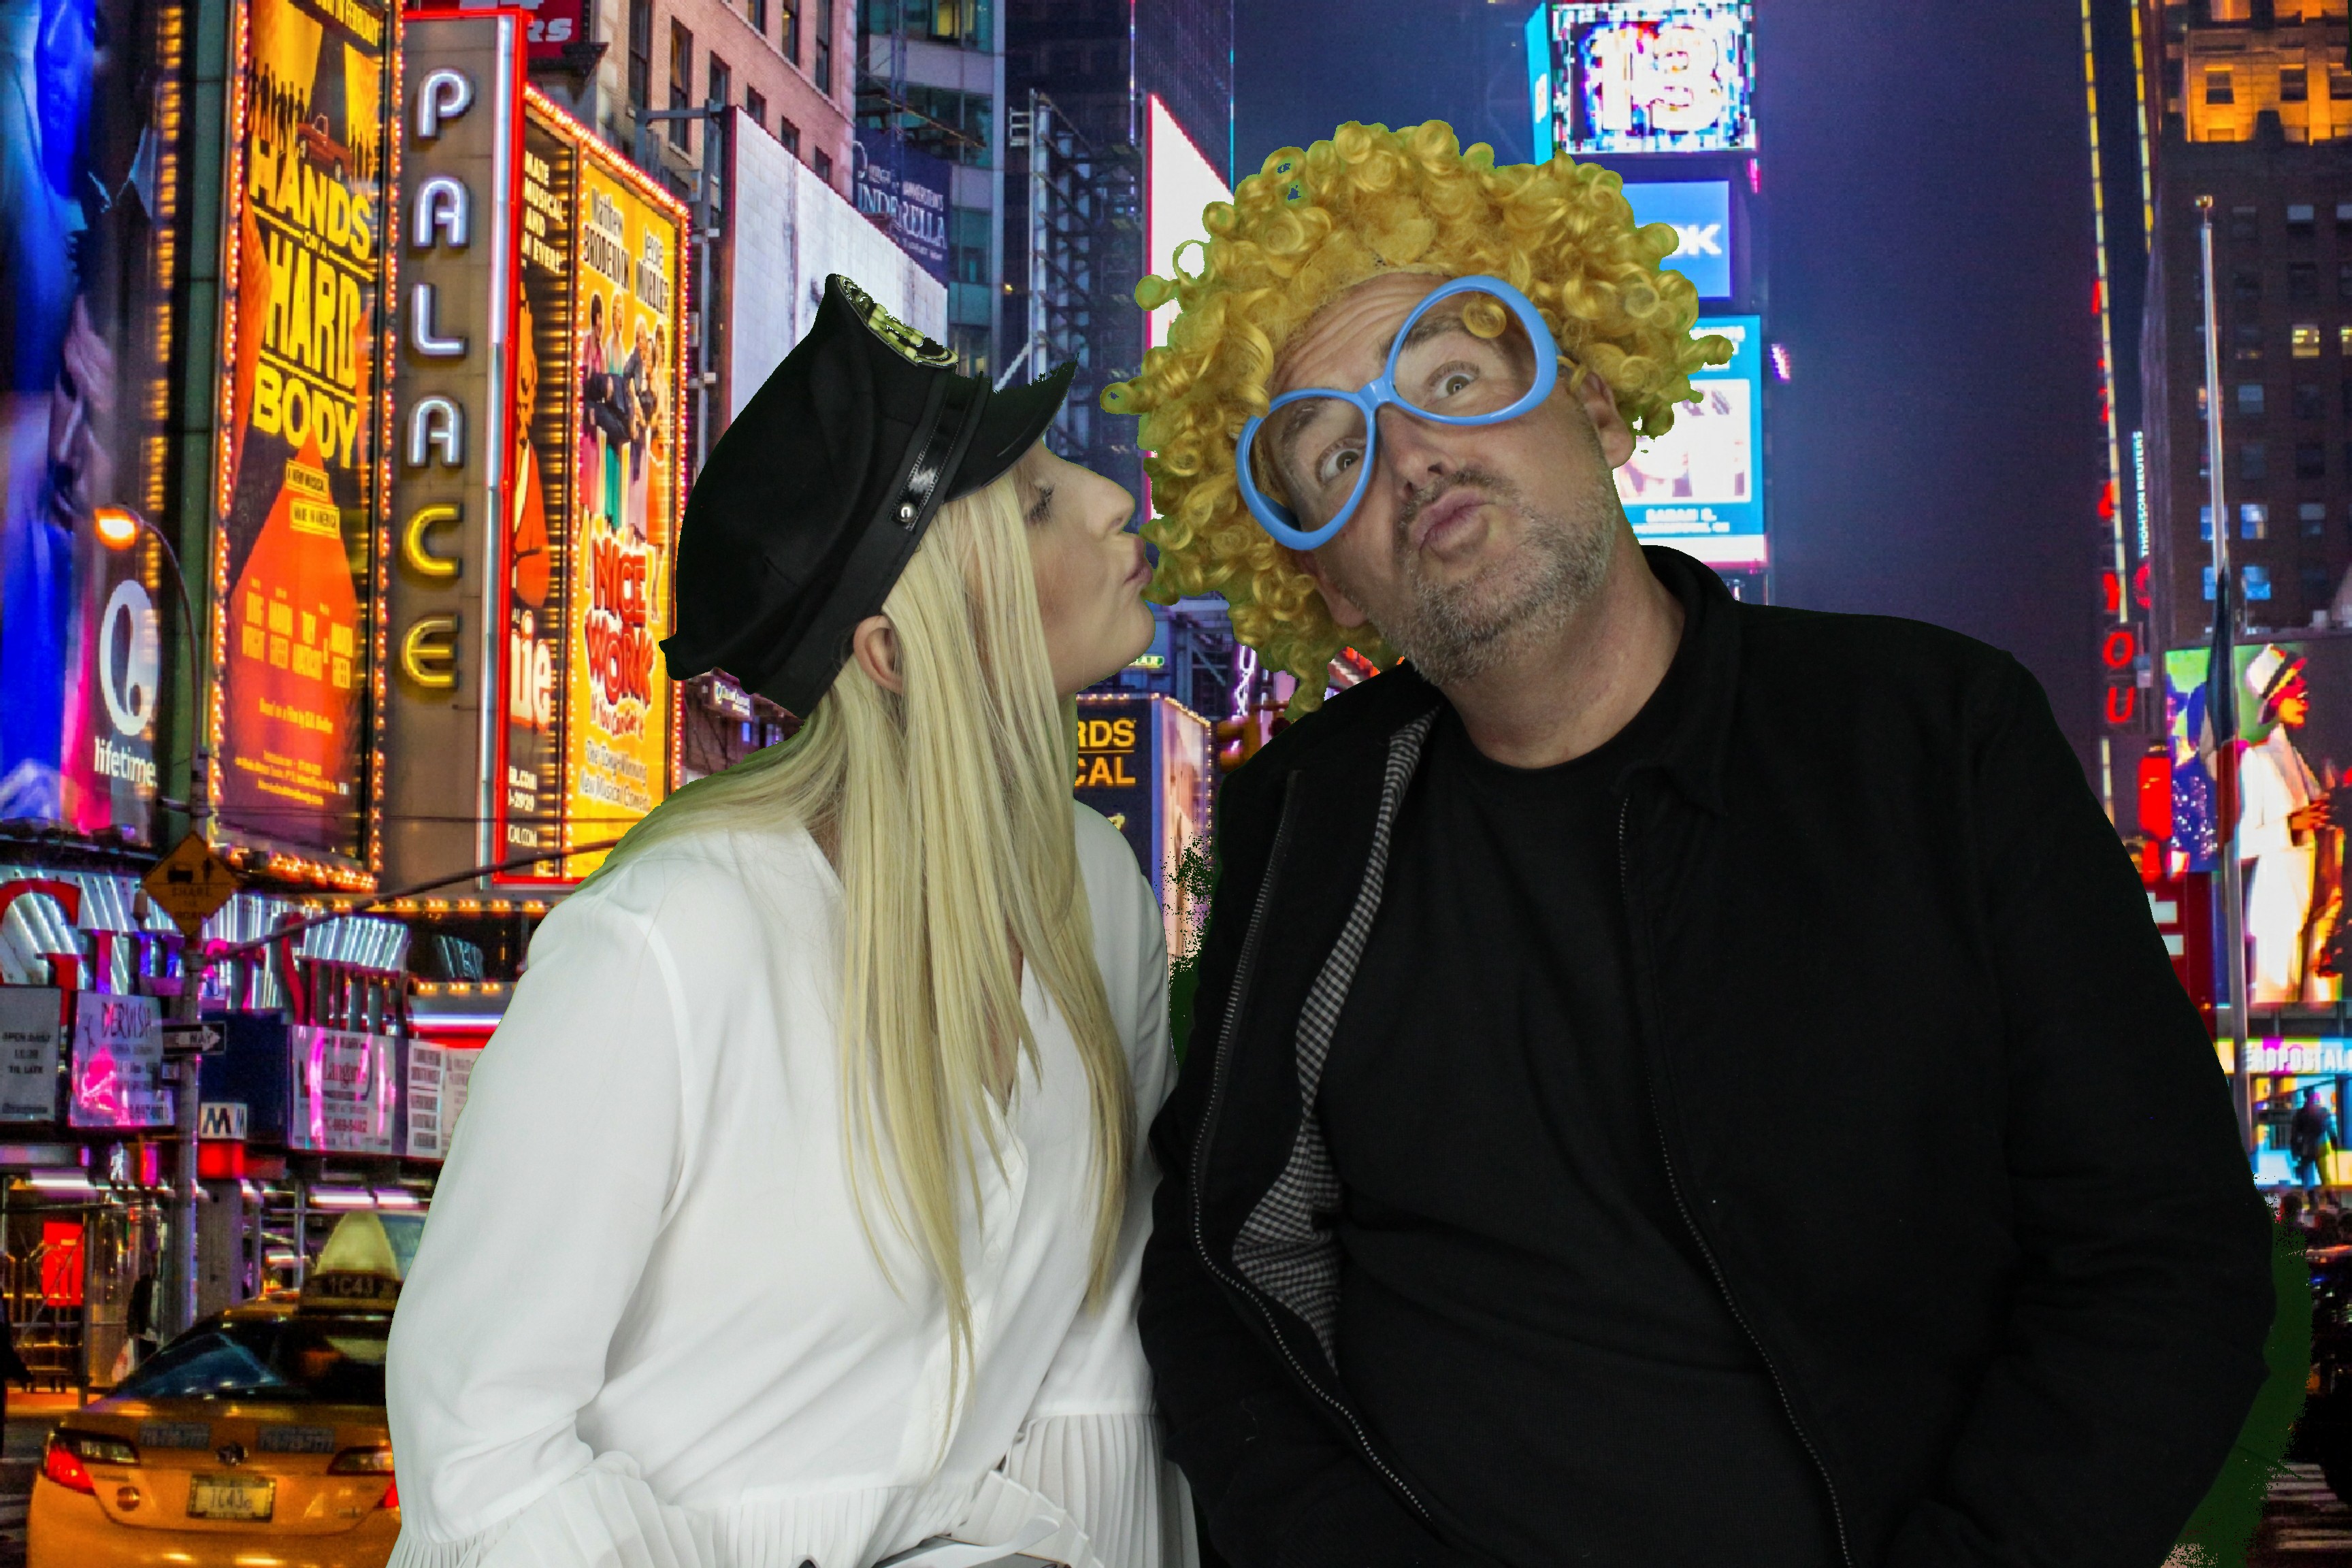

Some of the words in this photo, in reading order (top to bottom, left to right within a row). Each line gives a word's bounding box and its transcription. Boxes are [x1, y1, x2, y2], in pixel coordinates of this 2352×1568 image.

[249, 135, 371, 260] HANDS
[525, 206, 546, 238] AND
[265, 231, 361, 389] HARD
[252, 365, 358, 469] BODY
[402, 69, 474, 689] PALACE
[593, 536, 647, 627] NICE
[585, 611, 654, 709] WORK
